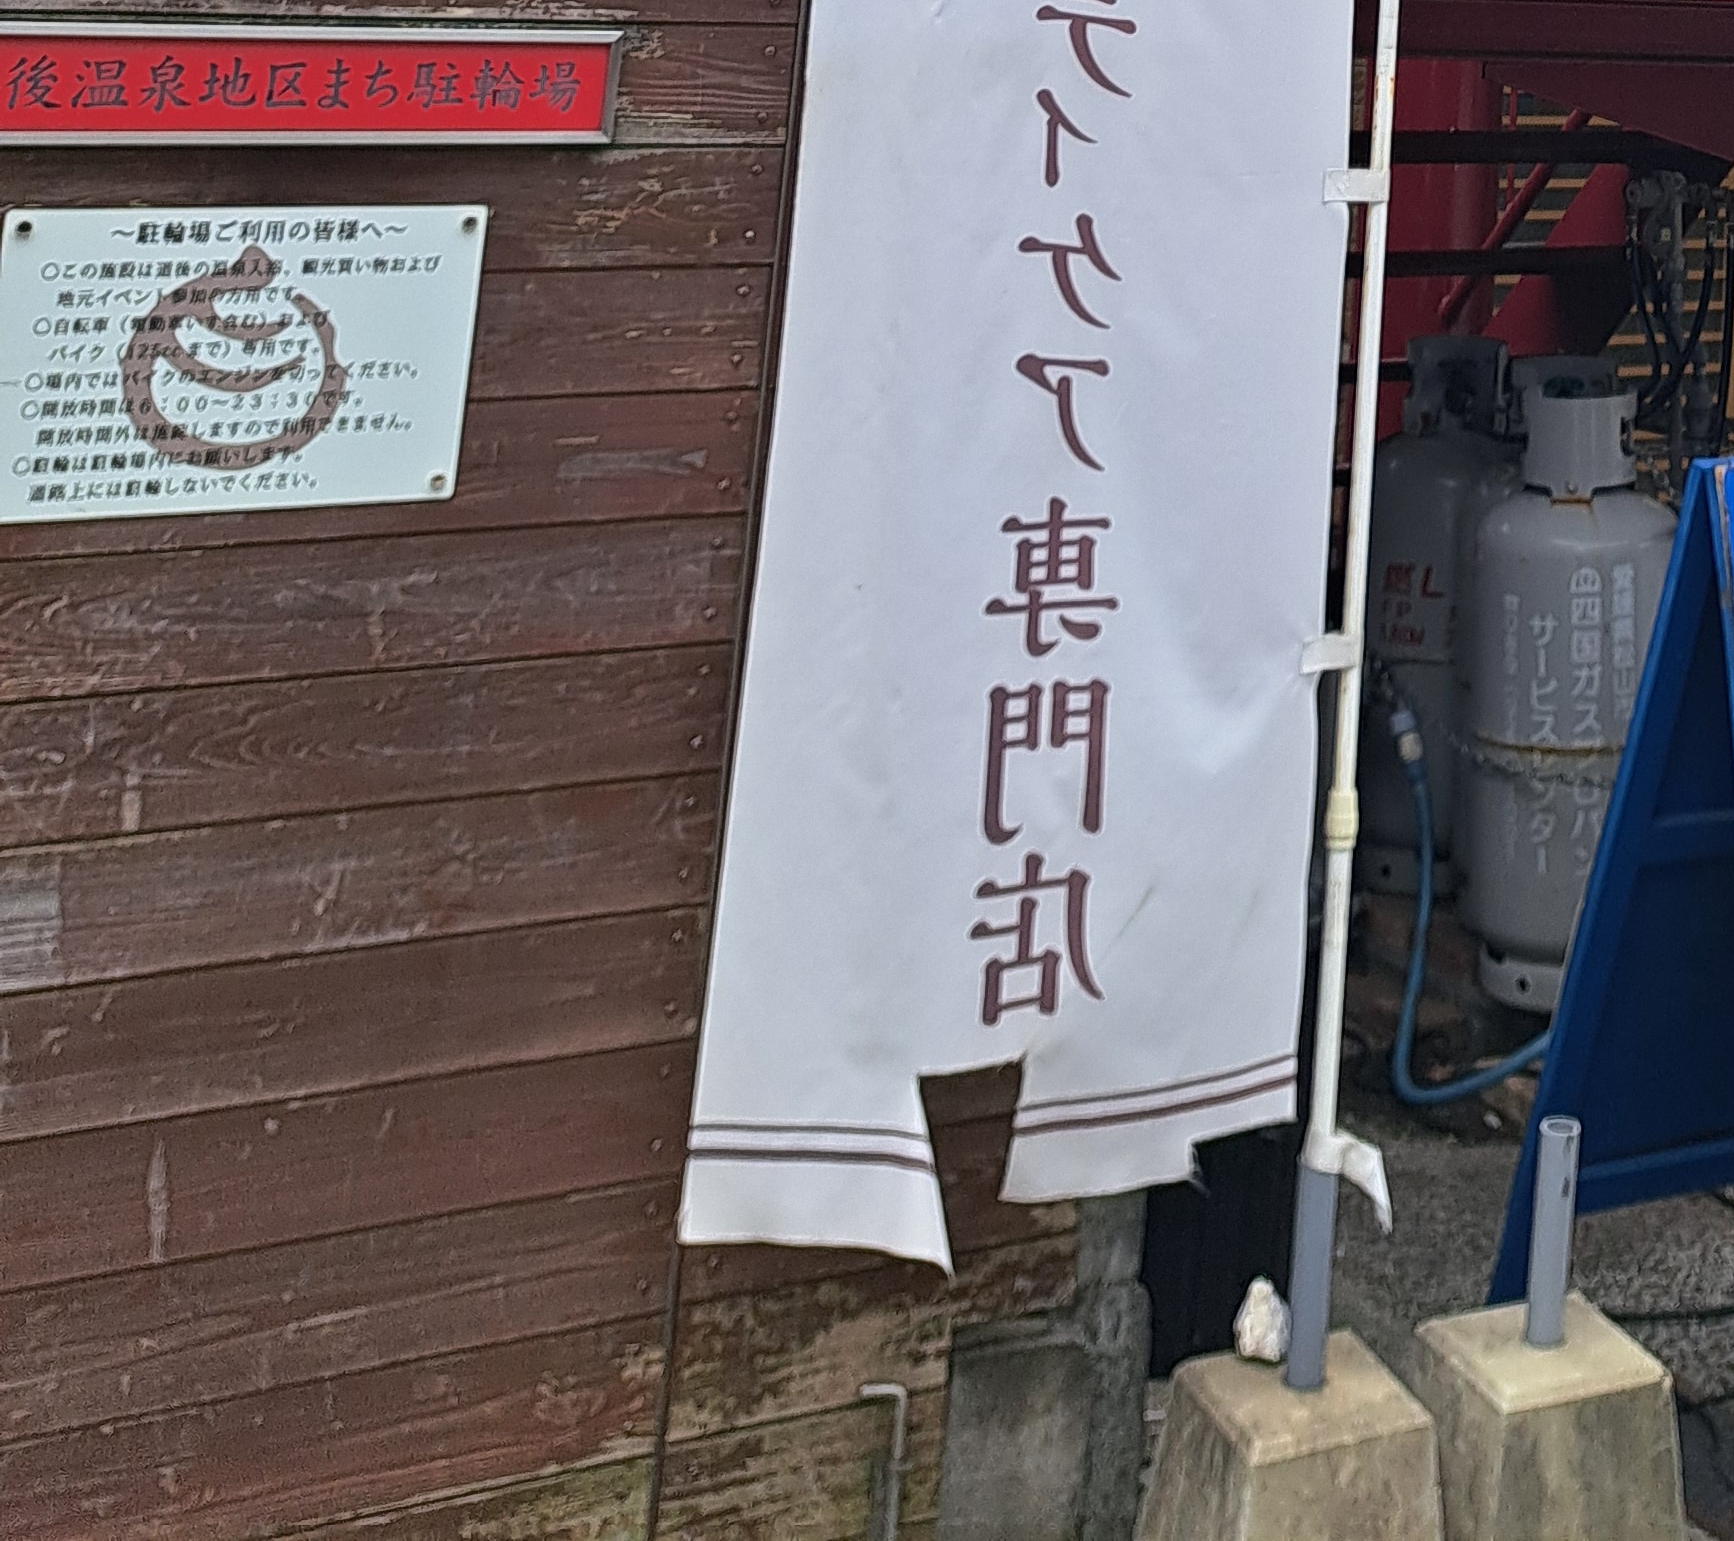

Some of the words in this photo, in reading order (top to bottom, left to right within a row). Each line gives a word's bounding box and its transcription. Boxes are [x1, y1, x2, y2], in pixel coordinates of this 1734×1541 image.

[6, 54, 582, 114] 後温泉地区まち駐輪場
